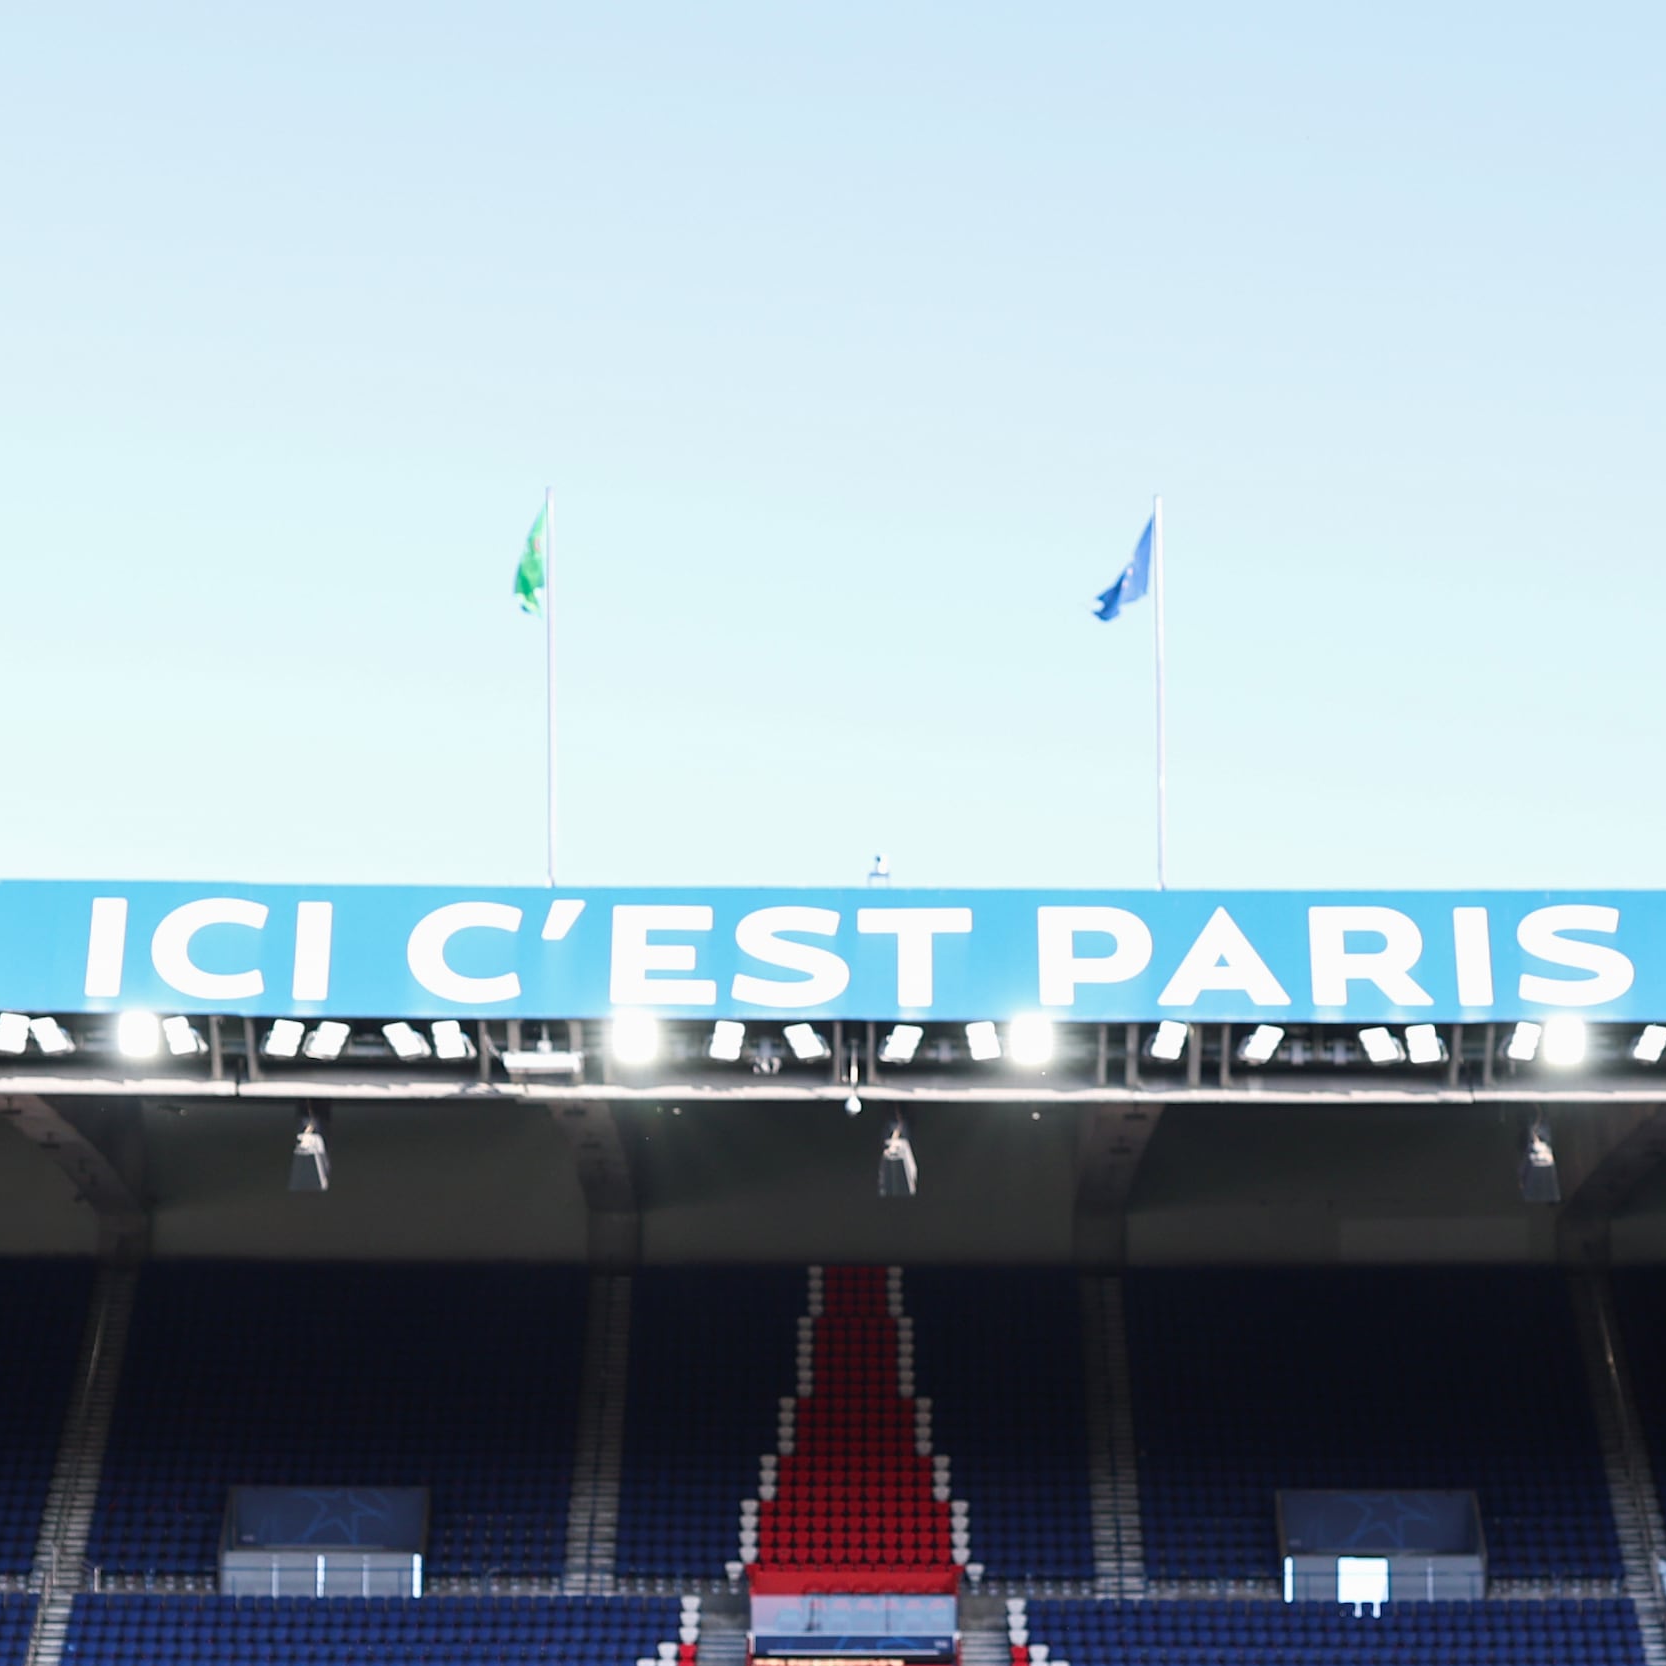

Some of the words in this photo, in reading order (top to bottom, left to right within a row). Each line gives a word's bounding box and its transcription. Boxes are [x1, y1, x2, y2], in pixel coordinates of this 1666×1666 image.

[85, 897, 332, 1001] ICI
[406, 898, 973, 1008] C'EST
[1037, 904, 1635, 1006] PARIS
